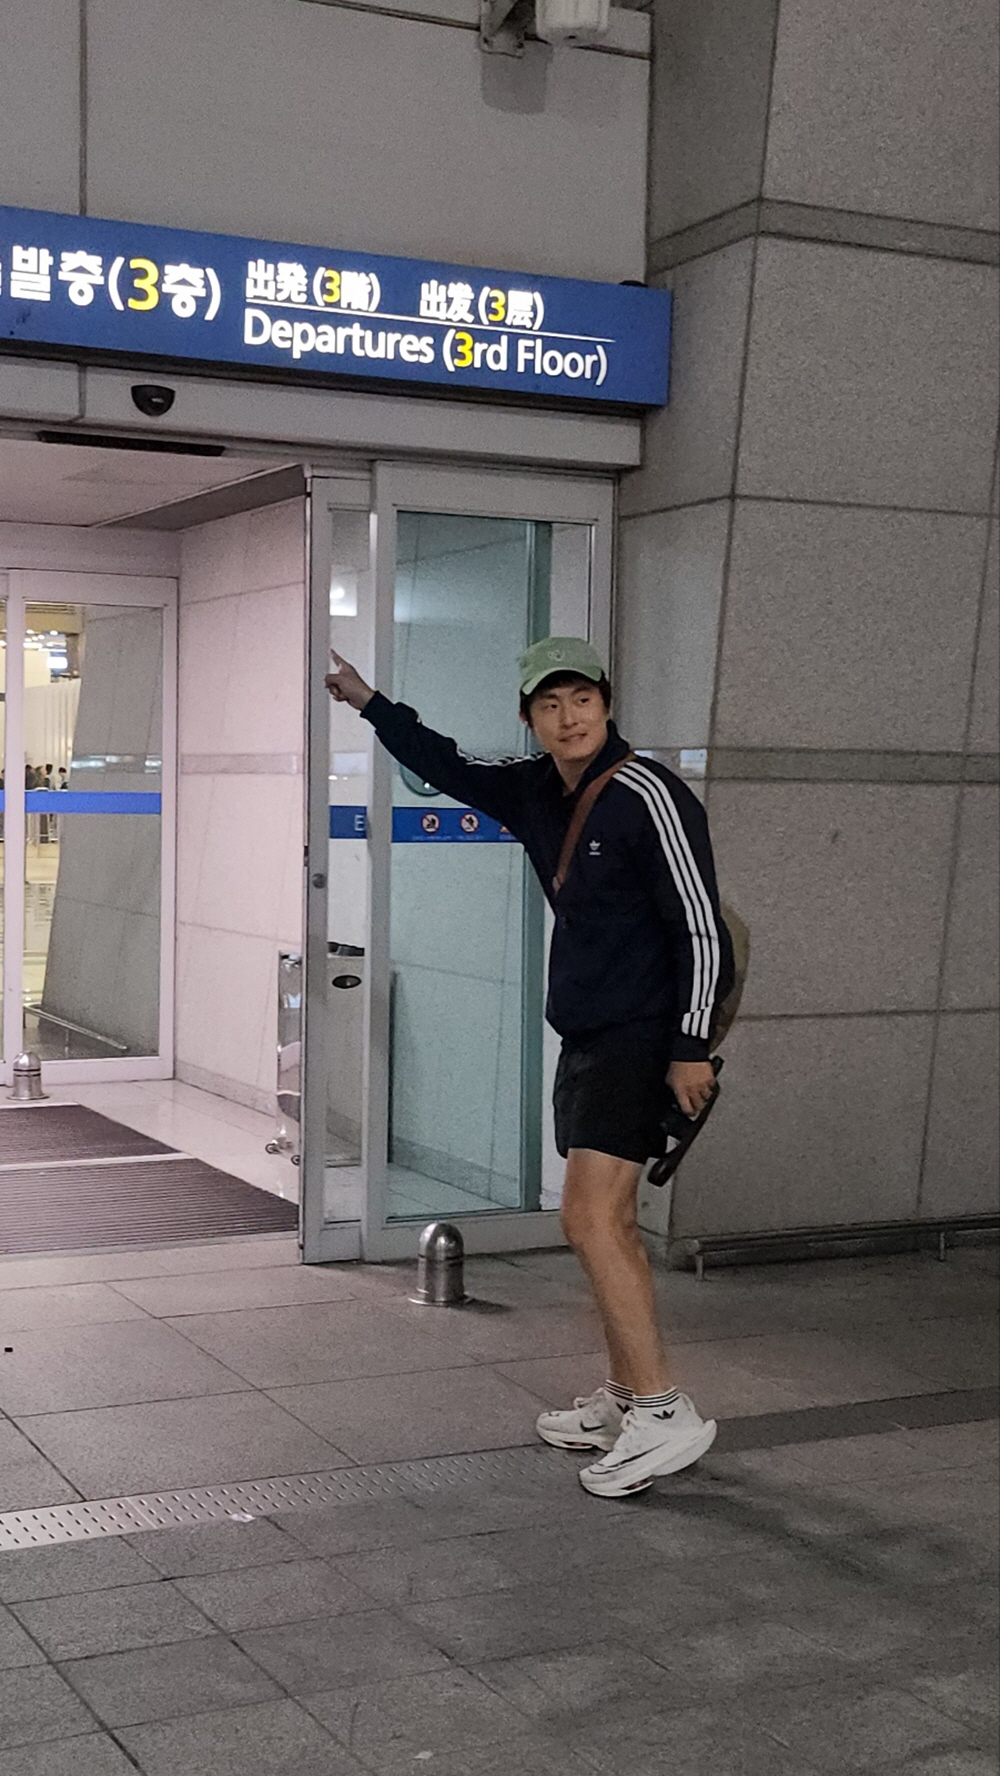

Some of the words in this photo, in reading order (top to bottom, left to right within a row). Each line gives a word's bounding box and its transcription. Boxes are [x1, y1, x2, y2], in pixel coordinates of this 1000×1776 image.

[0, 245, 222, 320] 발층(3층)
[244, 308, 435, 363] Departures
[443, 329, 508, 372] (3rd
[517, 339, 607, 385] Floor)
